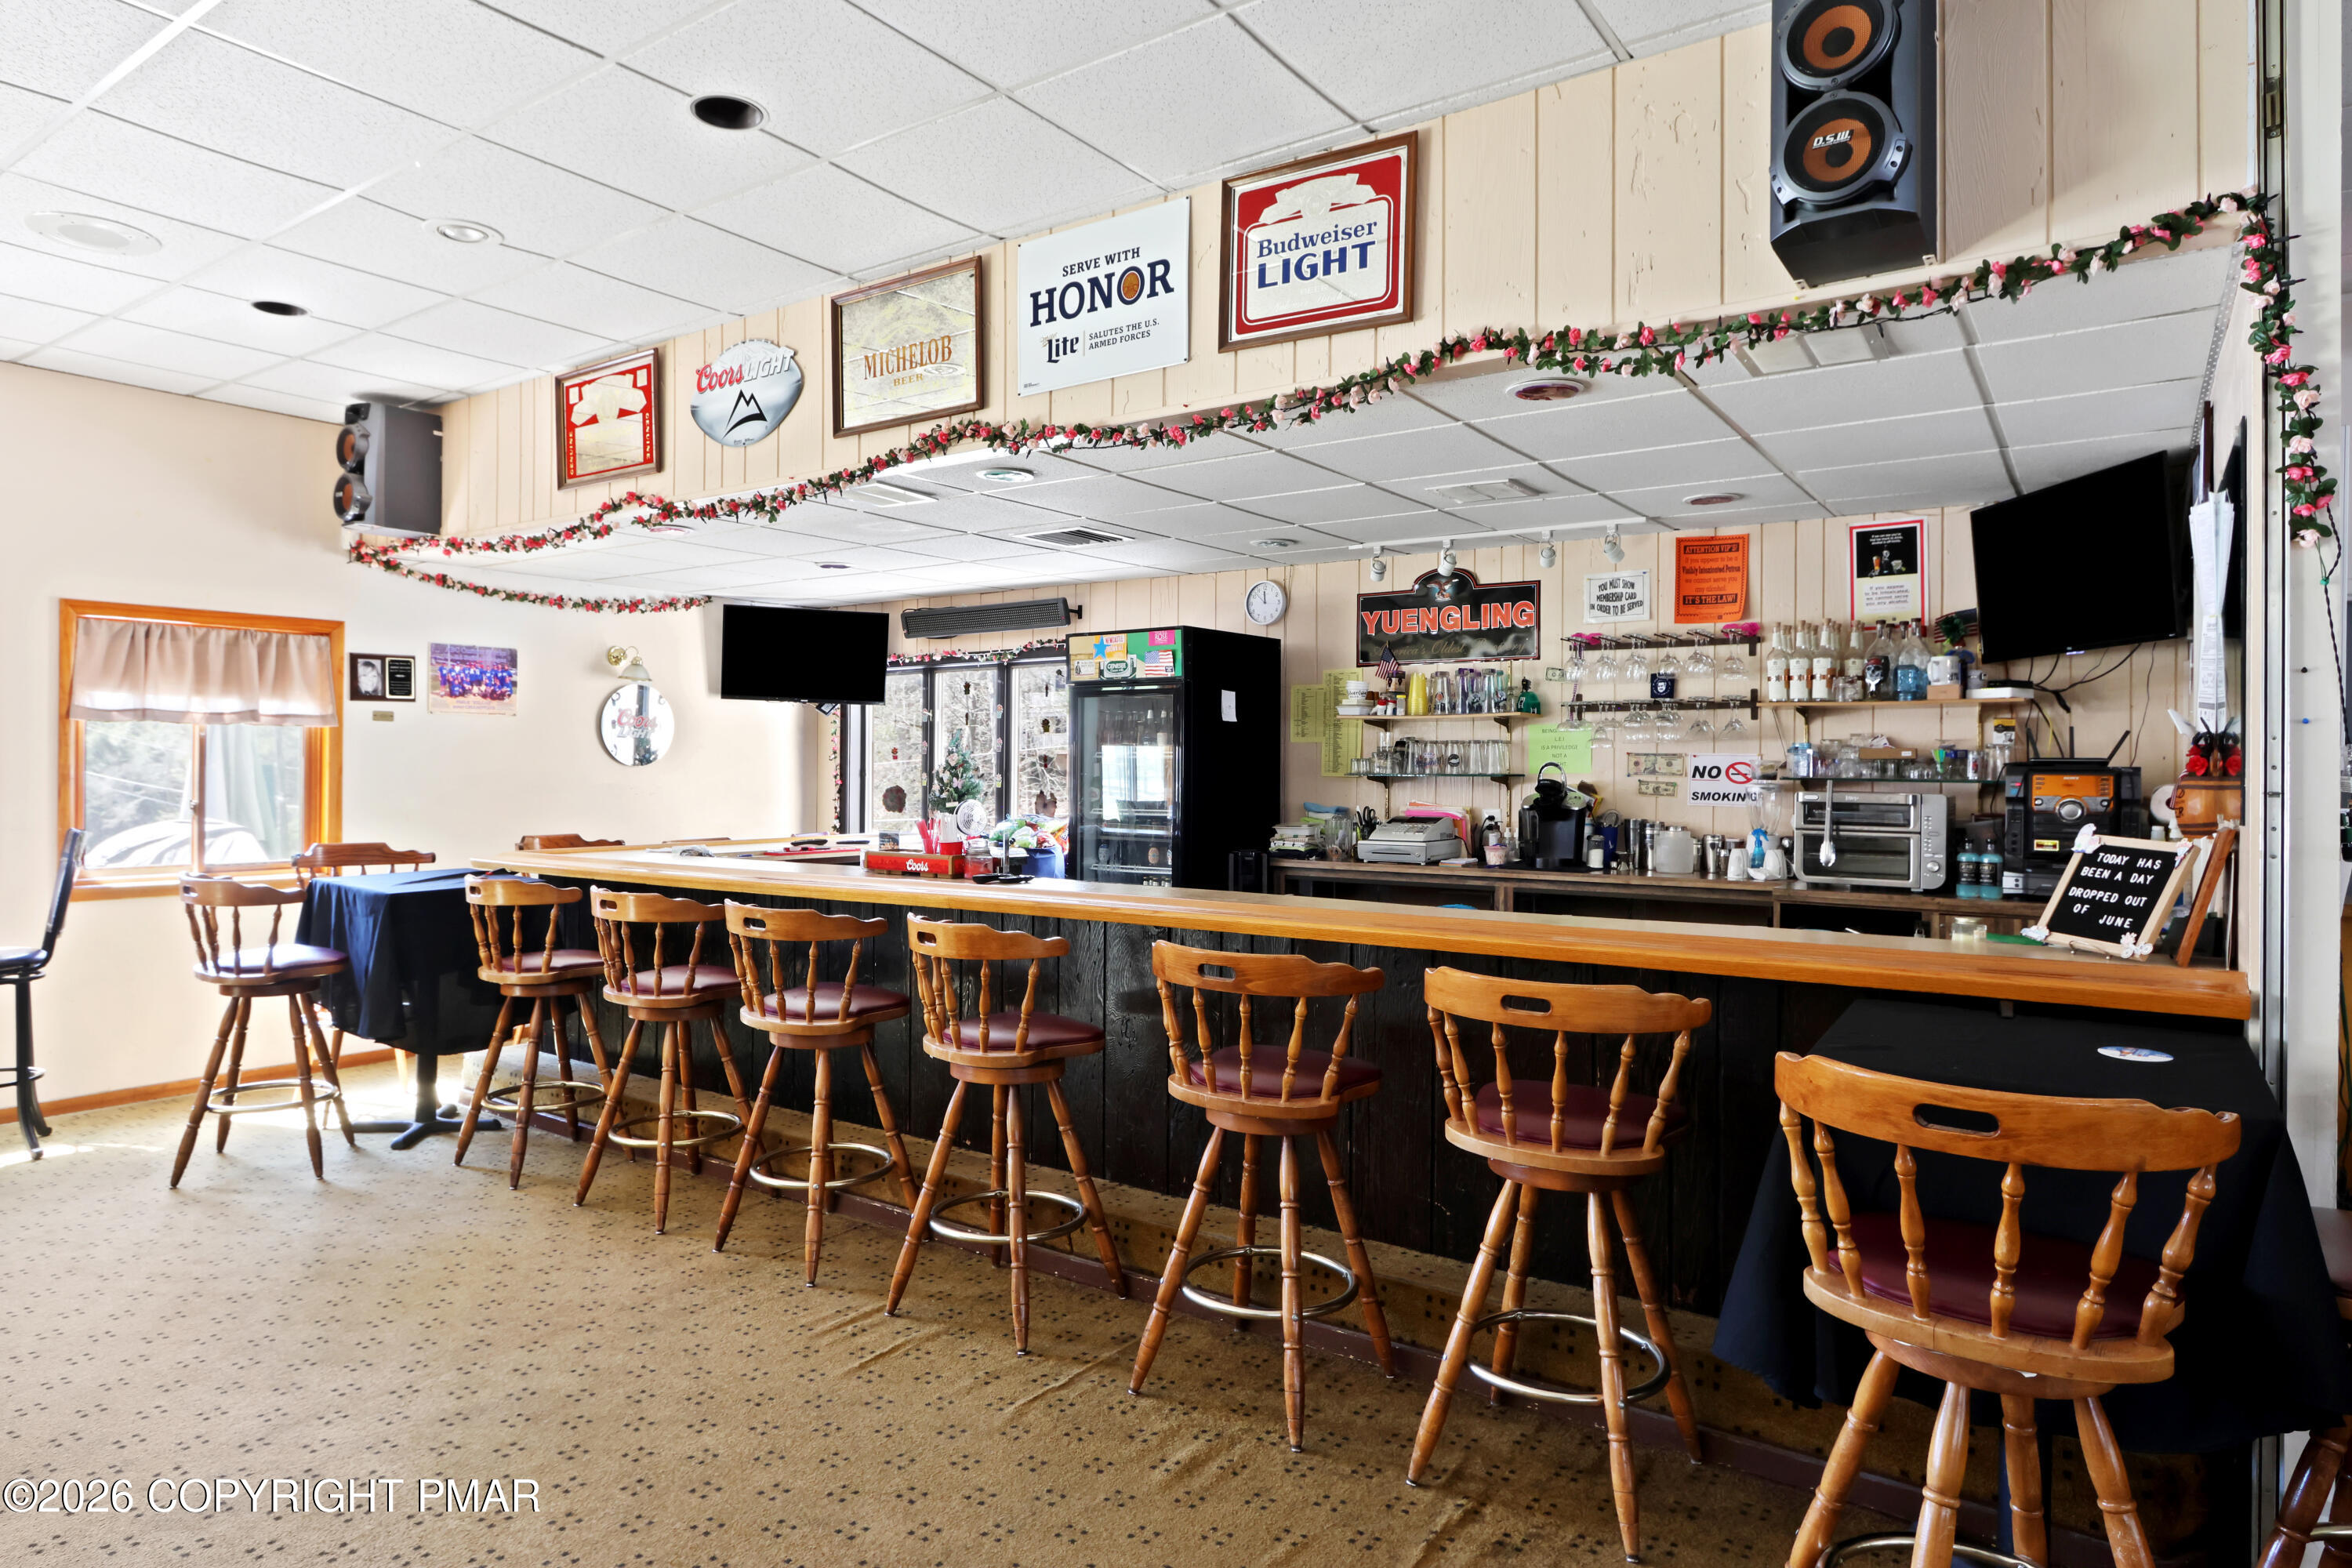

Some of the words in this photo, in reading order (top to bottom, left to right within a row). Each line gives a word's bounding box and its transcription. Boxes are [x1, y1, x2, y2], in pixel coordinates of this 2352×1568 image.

[1813, 129, 1851, 146] D.S.W.
[1257, 220, 1377, 259] Budweiser
[1062, 257, 1101, 278] SERVE
[1104, 247, 1141, 265] WITH
[1258, 240, 1376, 289] LIGHT
[1029, 258, 1174, 328] HONOR
[1088, 326, 1124, 340] SALUTES
[1126, 322, 1142, 335] THE
[1145, 318, 1160, 331] U.S.
[1088, 336, 1118, 350] ARMED
[1120, 329, 1151, 344] FORCES
[864, 335, 953, 380] MICHELOB
[1046, 336, 1080, 364] Lite
[695, 364, 744, 394] Coors
[743, 346, 796, 383] LIGHT
[893, 373, 924, 387] BEER
[1598, 582, 1608, 592] YOU
[1609, 579, 1621, 590] MUST
[1622, 579, 1635, 590] SHOW
[1596, 592, 1624, 602] MEMBERSHIP
[1625, 592, 1637, 601] CARD
[1701, 595, 1717, 604] THE
[1597, 604, 1611, 615] ORDER
[1613, 605, 1618, 615] TO
[1620, 604, 1625, 615] BE
[1627, 601, 1643, 612] SERVED
[1361, 601, 1535, 635] YUENGLING
[1431, 639, 1465, 655] Oldest
[617, 708, 659, 728] Coors
[1691, 765, 1722, 779] NO
[1691, 791, 1757, 802] SMOKING
[906, 858, 929, 872] Coors
[2096, 852, 2130, 866] TODAY
[2136, 857, 2161, 870] HAS
[2080, 866, 2111, 880] BEEN
[2114, 872, 2123, 881] A
[2129, 872, 2154, 885] DAY
[2068, 886, 2119, 903] DROPPED
[2124, 895, 2147, 908] OUT
[2072, 903, 2090, 914] OF
[2098, 914, 2133, 929] JUNE
